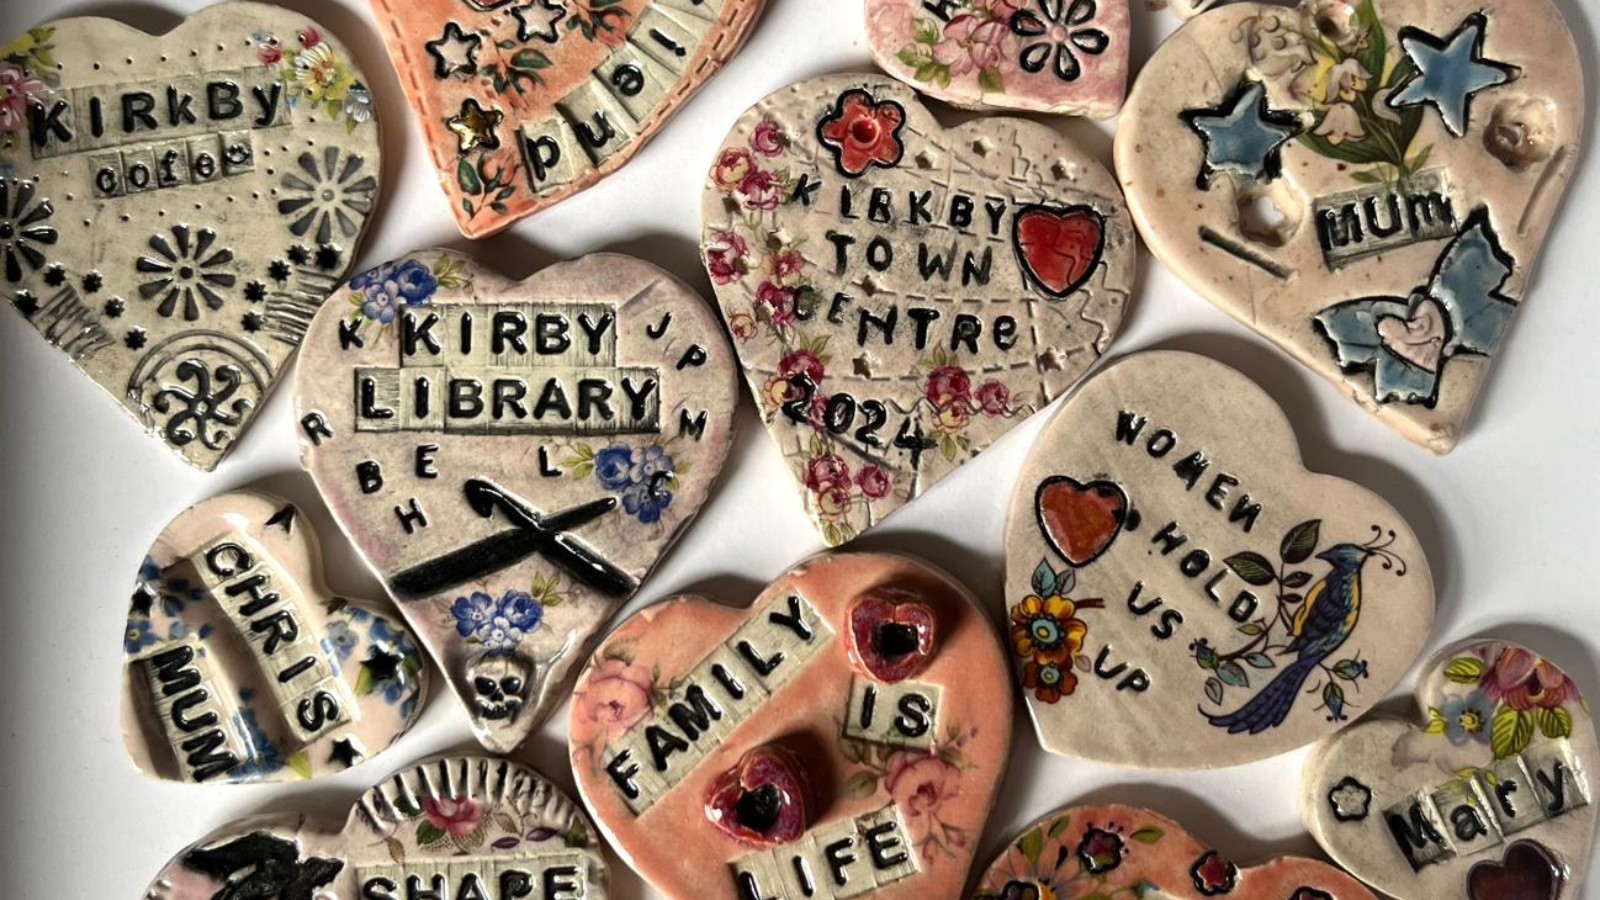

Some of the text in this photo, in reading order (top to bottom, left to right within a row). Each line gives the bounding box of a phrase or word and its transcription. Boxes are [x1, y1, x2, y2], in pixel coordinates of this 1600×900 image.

[528, 0, 704, 181] iend
[825, 229, 993, 287] TOWN
[338, 316, 366, 351] K
[402, 311, 616, 356] KIRBY
[646, 311, 673, 340] J
[676, 343, 707, 370] P
[361, 376, 659, 421] LIBRARY
[781, 372, 938, 469] 2024
[301, 412, 334, 446] R
[679, 408, 708, 441] M
[356, 459, 383, 495] B
[416, 444, 439, 479] E
[538, 444, 562, 477] L
[1116, 410, 1263, 533] WOMEN
[394, 498, 428, 534] H
[1151, 521, 1259, 623] HOLD
[1127, 581, 1183, 640] US
[206, 542, 339, 732] CHRIS
[1094, 645, 1151, 693] UP
[152, 645, 241, 782] MUM
[607, 595, 812, 799] FAMILY
[860, 684, 930, 737] IS
[1388, 761, 1564, 858] Mary
[363, 866, 579, 900] SHAPE
[738, 820, 909, 900] LIFE
